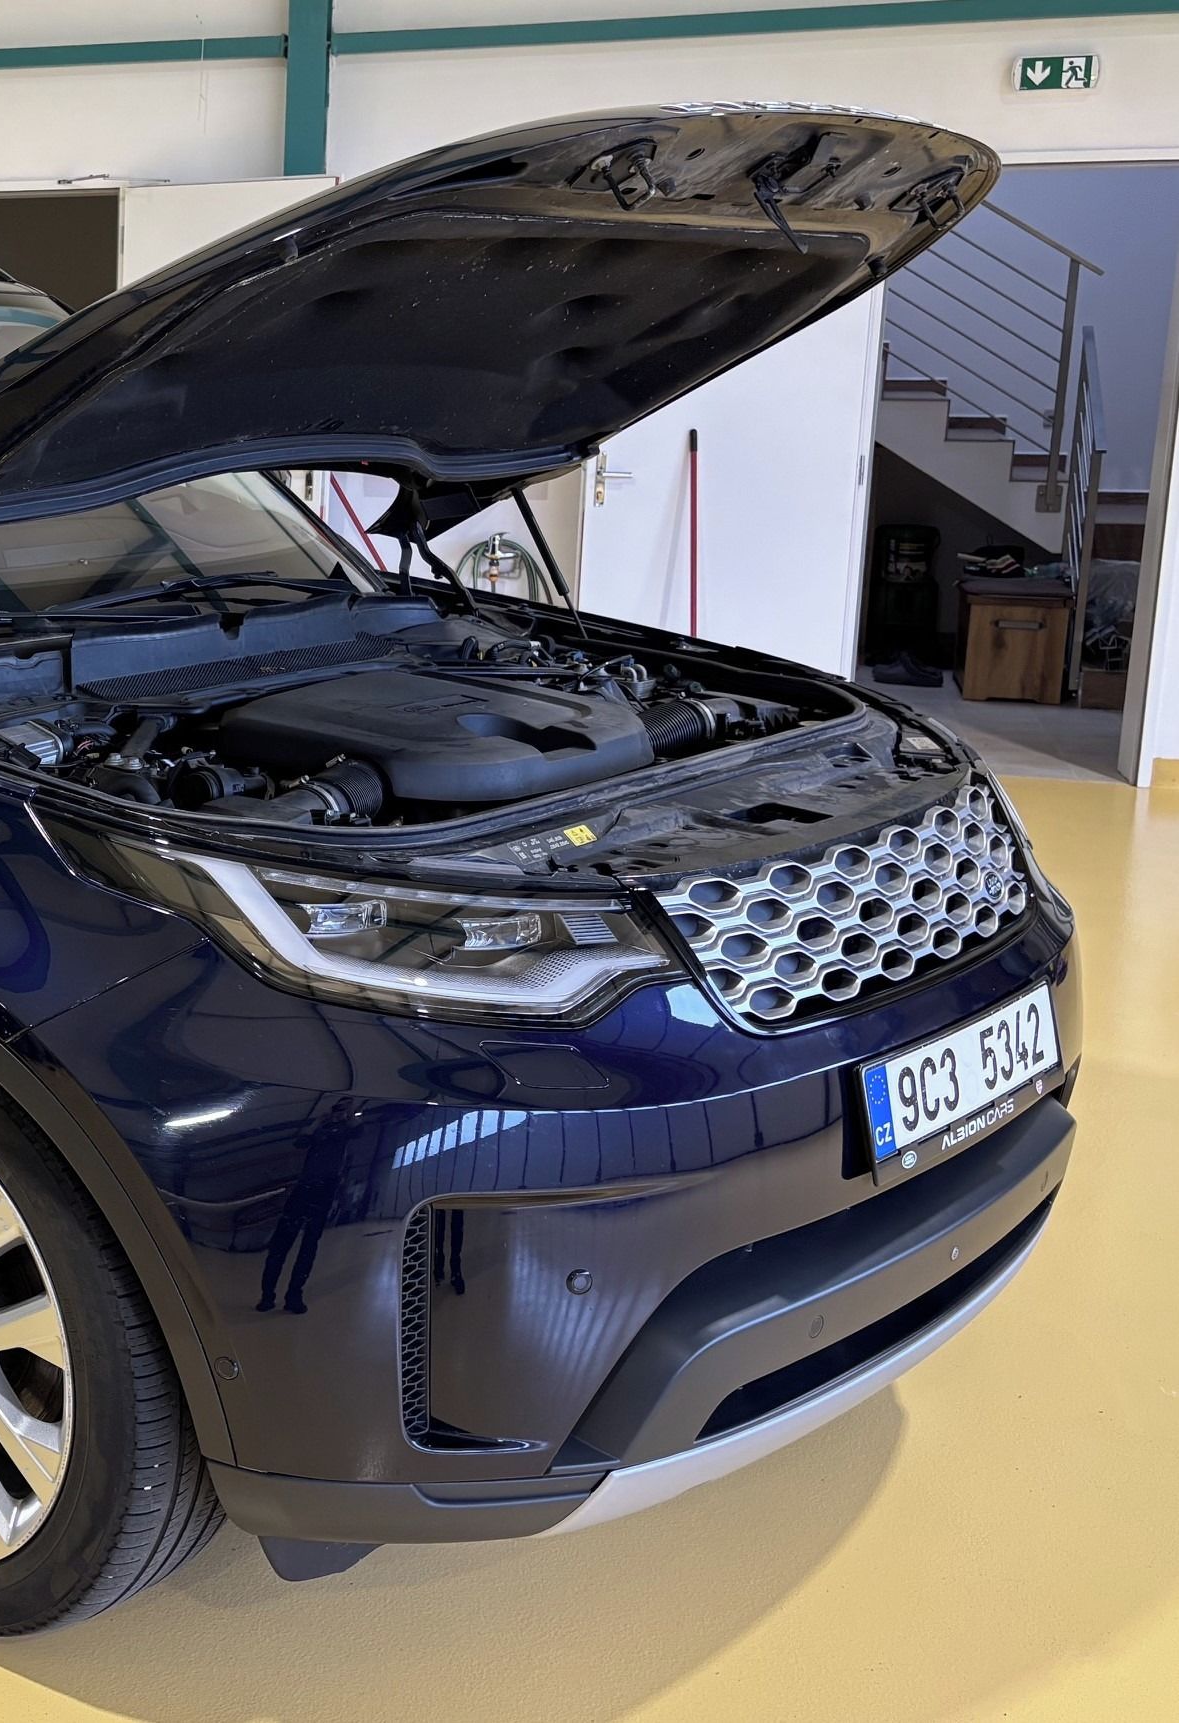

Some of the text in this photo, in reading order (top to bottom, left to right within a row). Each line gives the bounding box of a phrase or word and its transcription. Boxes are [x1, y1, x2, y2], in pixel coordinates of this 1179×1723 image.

[899, 1002, 1045, 1132] 9C3 5342
[876, 1122, 893, 1147] CZ
[941, 1098, 1015, 1151] ALBION CARS
